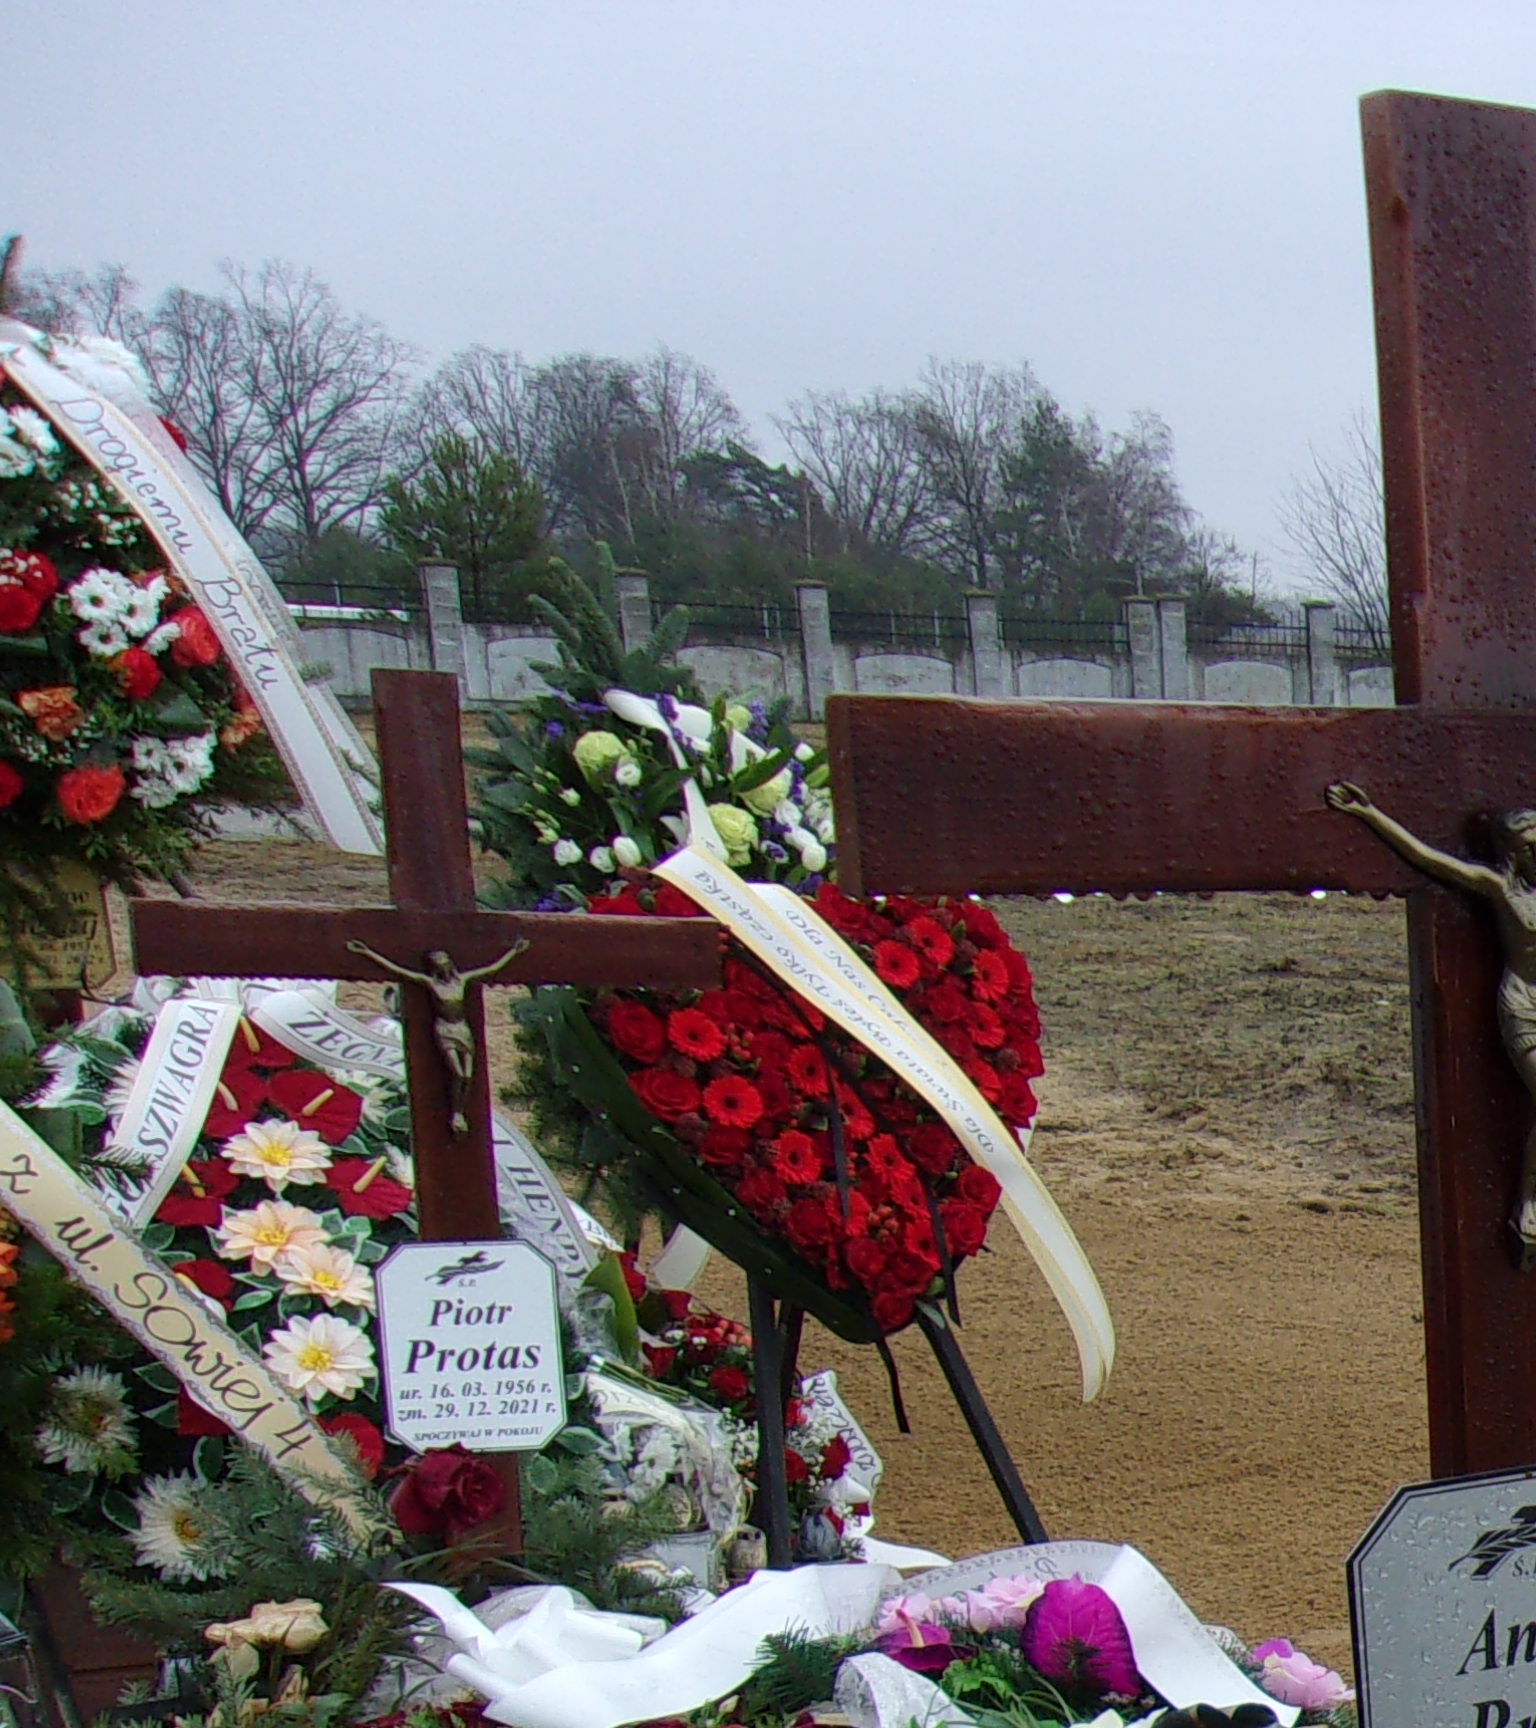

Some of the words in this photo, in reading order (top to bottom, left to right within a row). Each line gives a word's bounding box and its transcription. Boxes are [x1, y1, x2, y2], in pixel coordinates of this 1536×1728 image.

[50, 396, 194, 555] Drogiemu
[194, 575, 280, 690] Bratu
[138, 999, 219, 1161] SZWAGRA
[429, 1298, 512, 1327] Piotr
[54, 1216, 115, 1272] ul.
[273, 1412, 313, 1460] 4
[403, 1339, 541, 1374] Protas
[399, 1387, 423, 1400] ur.
[430, 1383, 455, 1399] 16.
[461, 1381, 487, 1397] 03.
[494, 1379, 535, 1396] 1956
[540, 1382, 552, 1394] r.
[397, 1409, 427, 1421] zm.
[433, 1403, 459, 1418] 29.
[467, 1401, 491, 1416] 12.
[498, 1399, 539, 1415] 2021
[544, 1401, 556, 1413] r.
[413, 1429, 481, 1441] SPOCZYWAJ
[484, 1428, 495, 1437] W
[499, 1426, 543, 1438] POKOJU
